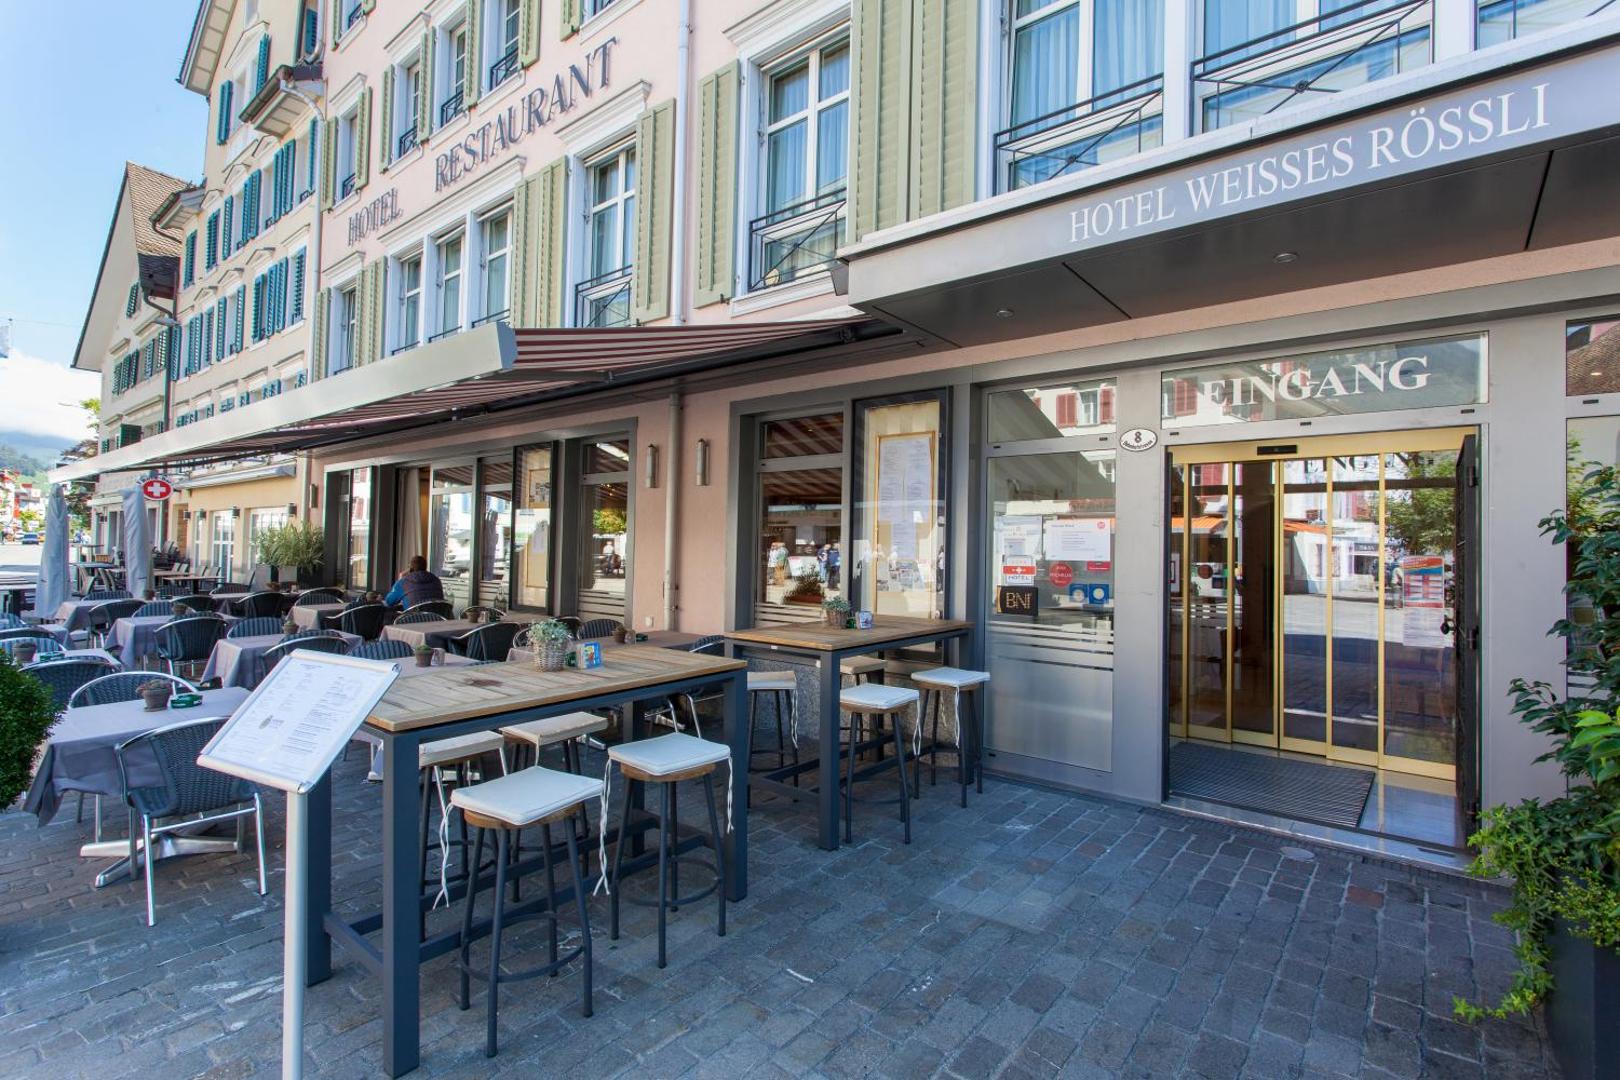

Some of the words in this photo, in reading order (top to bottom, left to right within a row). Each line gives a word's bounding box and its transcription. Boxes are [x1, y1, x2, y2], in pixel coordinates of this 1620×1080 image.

[348, 187, 402, 247] HOTEL
[434, 36, 617, 192] RESTAURANT
[1069, 187, 1176, 243] HOTEL
[1185, 135, 1354, 213] WEISSES
[1368, 82, 1552, 169] RÖSSLI
[1202, 355, 1432, 407] EINGANG
[1134, 431, 1142, 443] 8
